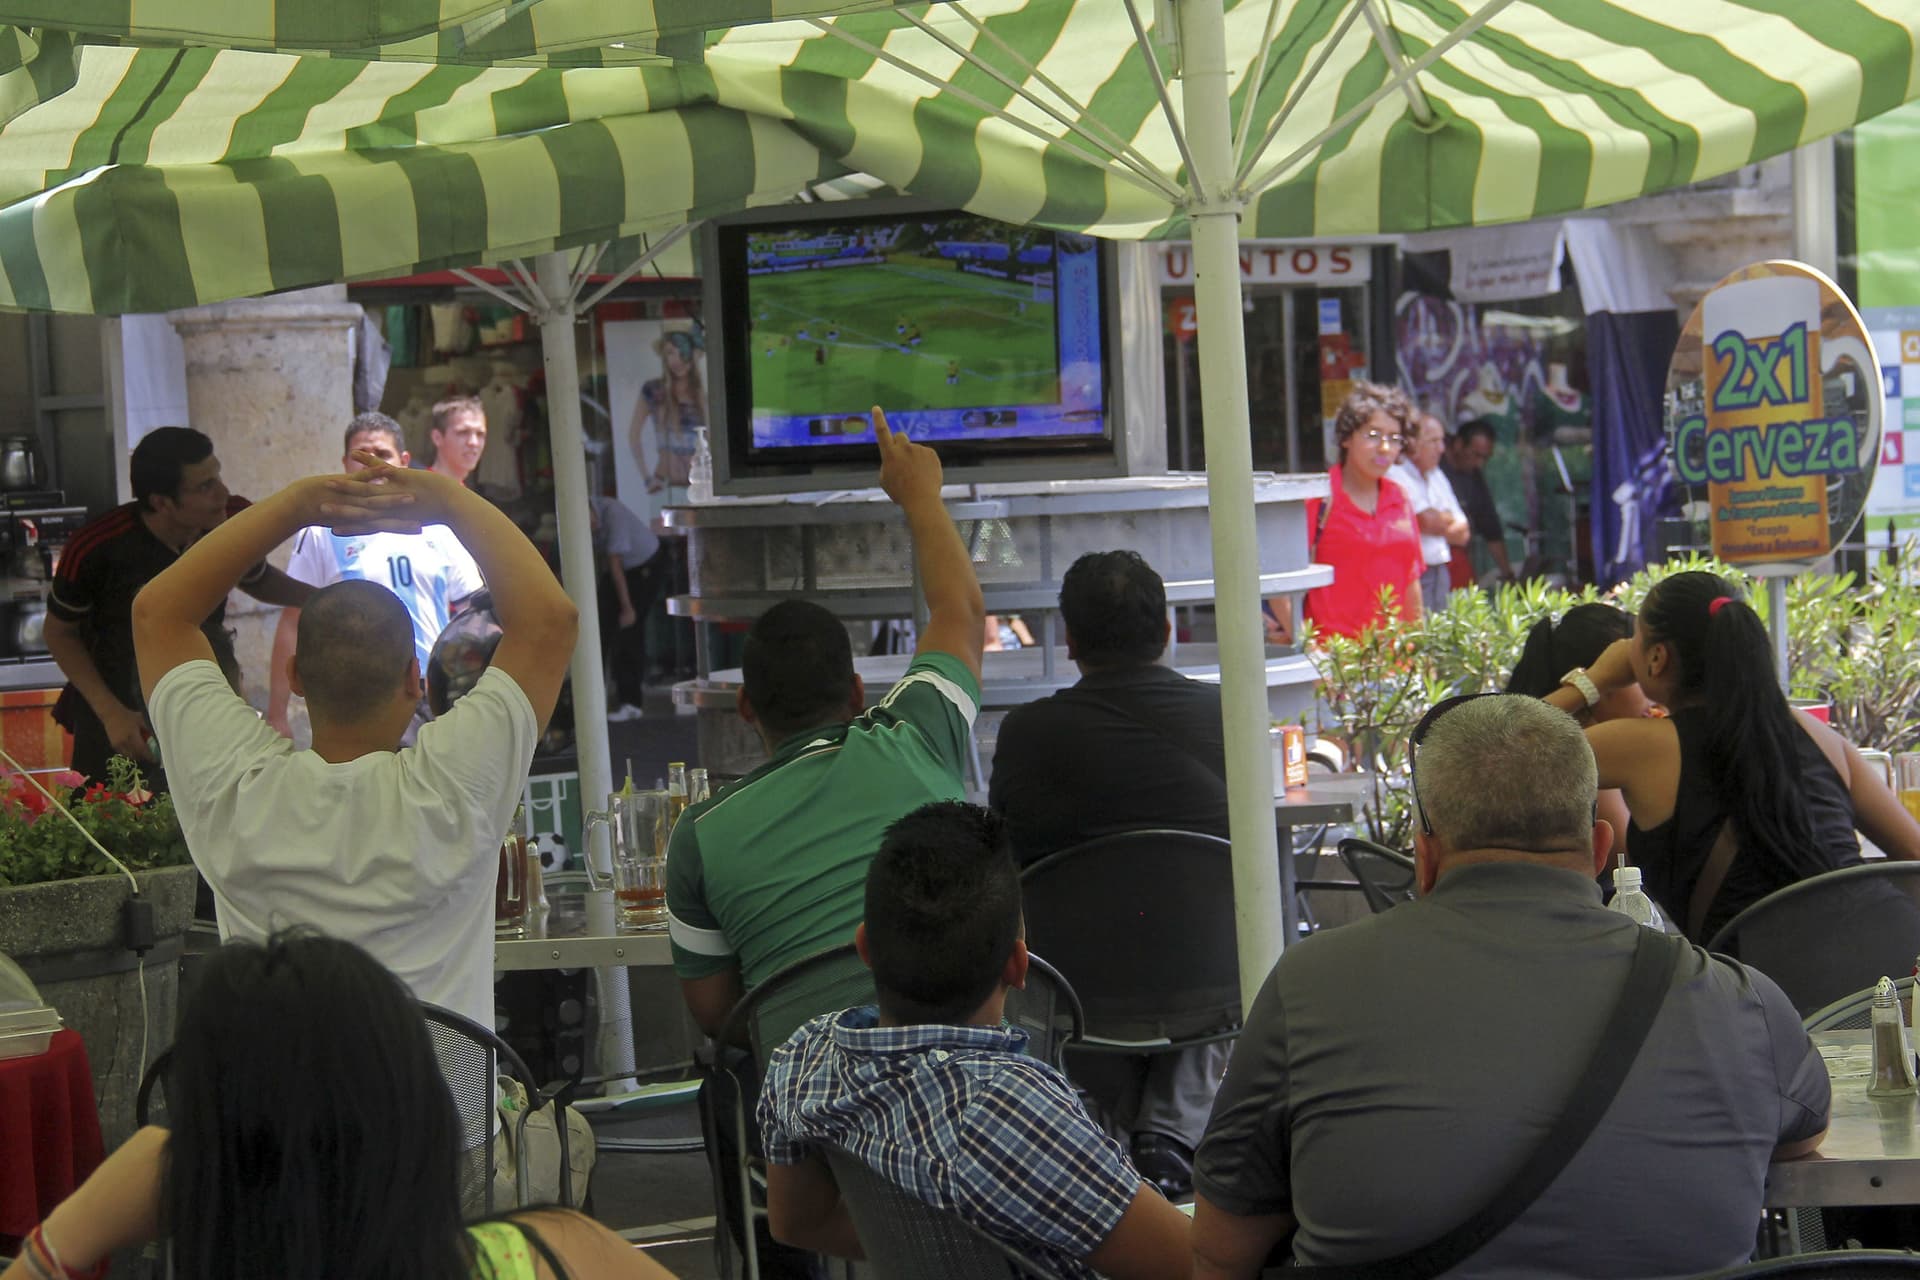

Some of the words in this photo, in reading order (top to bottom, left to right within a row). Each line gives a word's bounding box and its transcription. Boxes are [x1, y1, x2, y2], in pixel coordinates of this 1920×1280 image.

[1166, 247, 1353, 279] UNTOS
[1713, 322, 1808, 411] 2x1
[1676, 417, 1858, 484] Cerveza
[387, 555, 412, 588] 10
